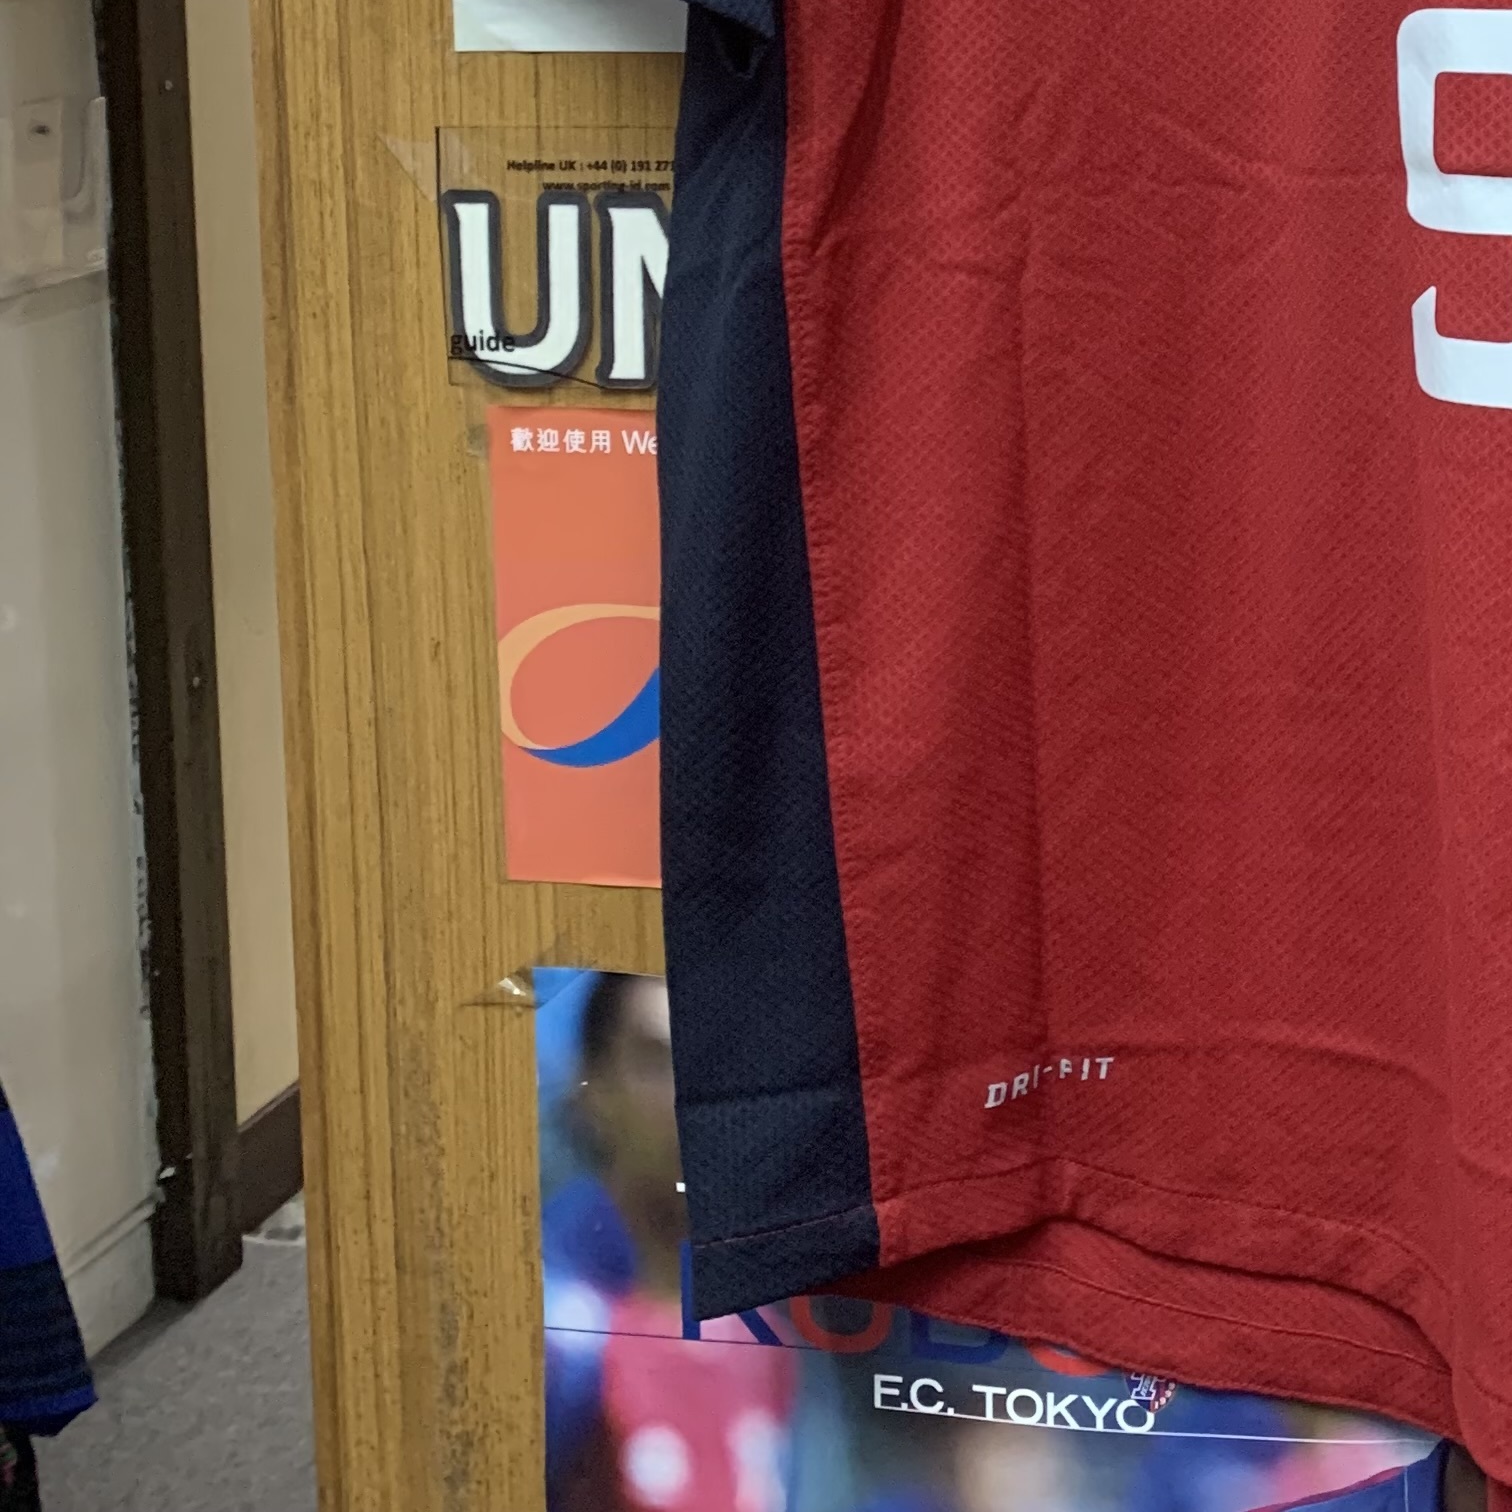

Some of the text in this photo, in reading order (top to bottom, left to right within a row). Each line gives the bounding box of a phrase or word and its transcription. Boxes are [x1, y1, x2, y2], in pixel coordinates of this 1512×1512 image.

[507, 159, 555, 172] Helpline
[559, 160, 576, 171] UK
[587, 160, 608, 171] +44
[631, 160, 652, 171] 191
[451, 330, 515, 355] guide
[984, 1057, 1115, 1109] DRI-FIT
[873, 1373, 955, 1415] F.C.
[972, 1384, 1154, 1434] TOKYO
